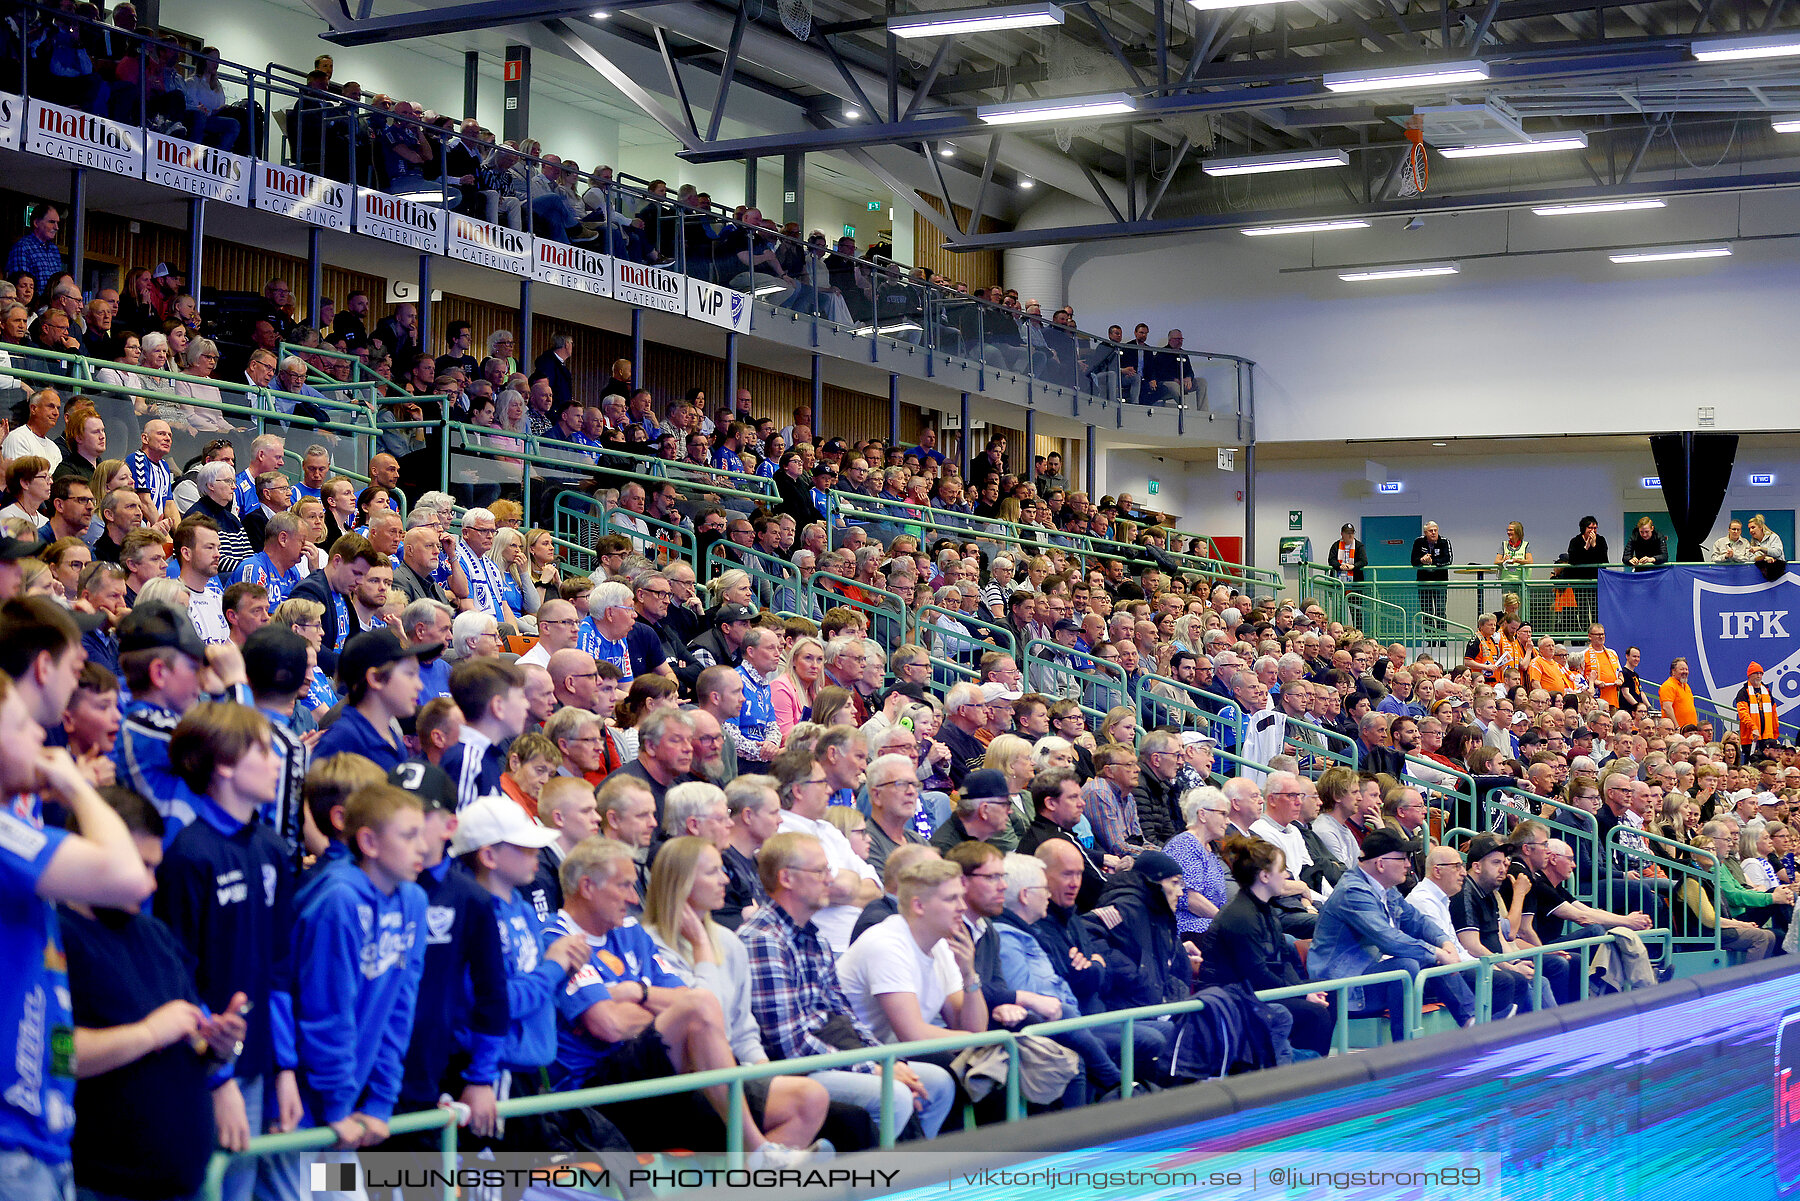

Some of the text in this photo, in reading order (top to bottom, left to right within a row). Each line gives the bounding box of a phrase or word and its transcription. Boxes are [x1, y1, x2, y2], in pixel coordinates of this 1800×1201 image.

[39, 106, 132, 152] mattias
[45, 141, 124, 173] CATERING
[158, 139, 241, 182] mattias
[163, 172, 233, 202] CATERING
[266, 167, 344, 209] mattias
[272, 199, 336, 228] CATERING
[366, 193, 437, 232] mattias
[371, 223, 431, 250] CATERING
[457, 219, 524, 254] mattias
[462, 247, 518, 273] CATERING
[540, 243, 604, 277] mattias
[393, 280, 409, 298] G
[545, 271, 600, 294] CATERING
[620, 264, 678, 295] mattias
[626, 290, 674, 312] CATERING
[697, 285, 723, 316] VIP
[946, 412, 959, 426] H
[1227, 453, 1233, 468] H
[1718, 611, 1790, 639] IFK
[745, 700, 753, 716] 7
